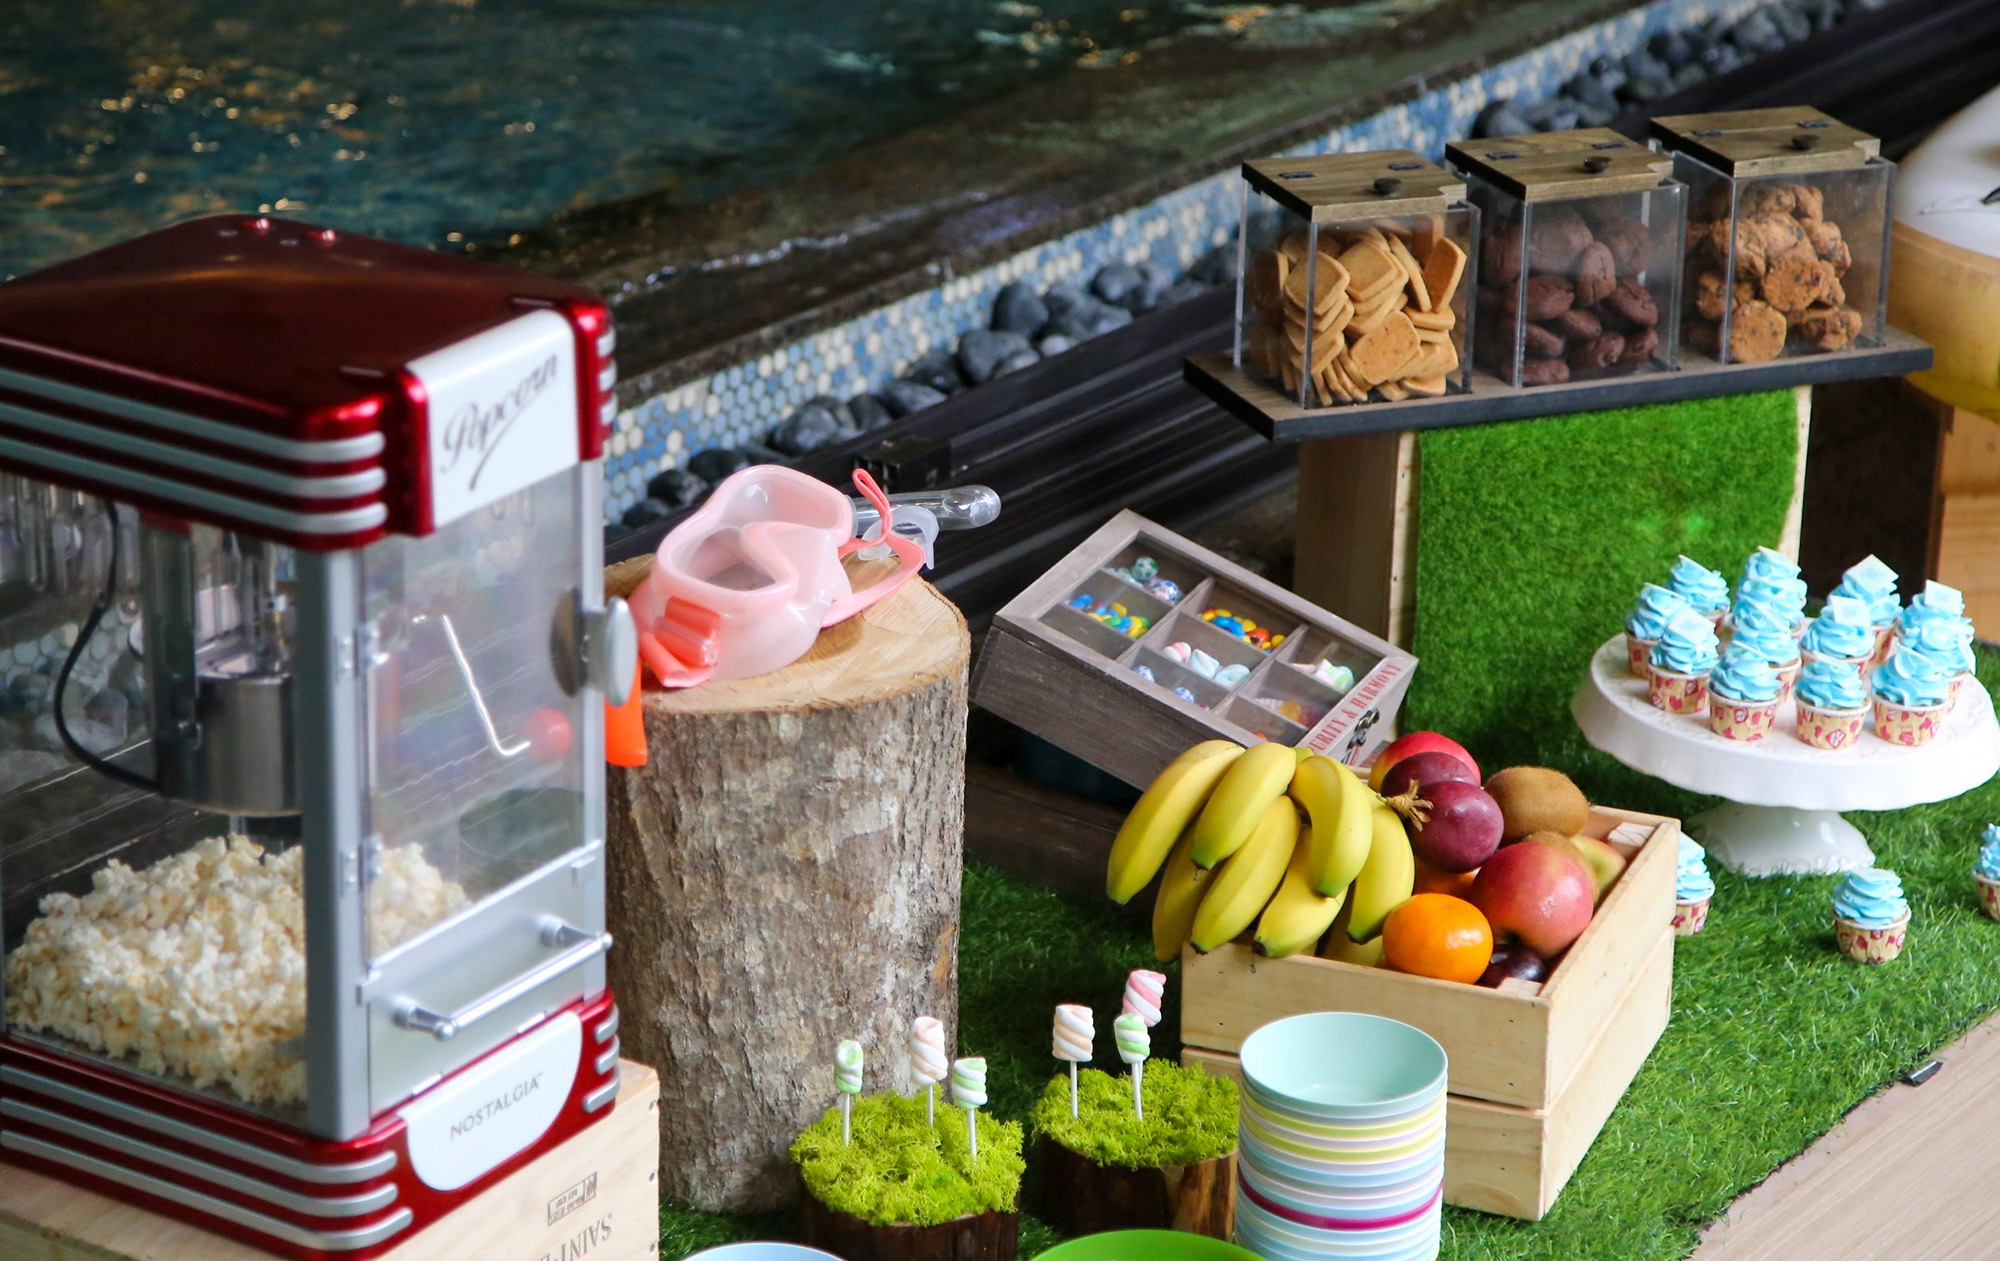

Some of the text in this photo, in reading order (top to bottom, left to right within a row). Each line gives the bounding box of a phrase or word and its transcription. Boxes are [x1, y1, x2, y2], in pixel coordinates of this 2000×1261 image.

[440, 354, 557, 492] Popcorn
[1308, 664, 1402, 751] URITY & HARMONY
